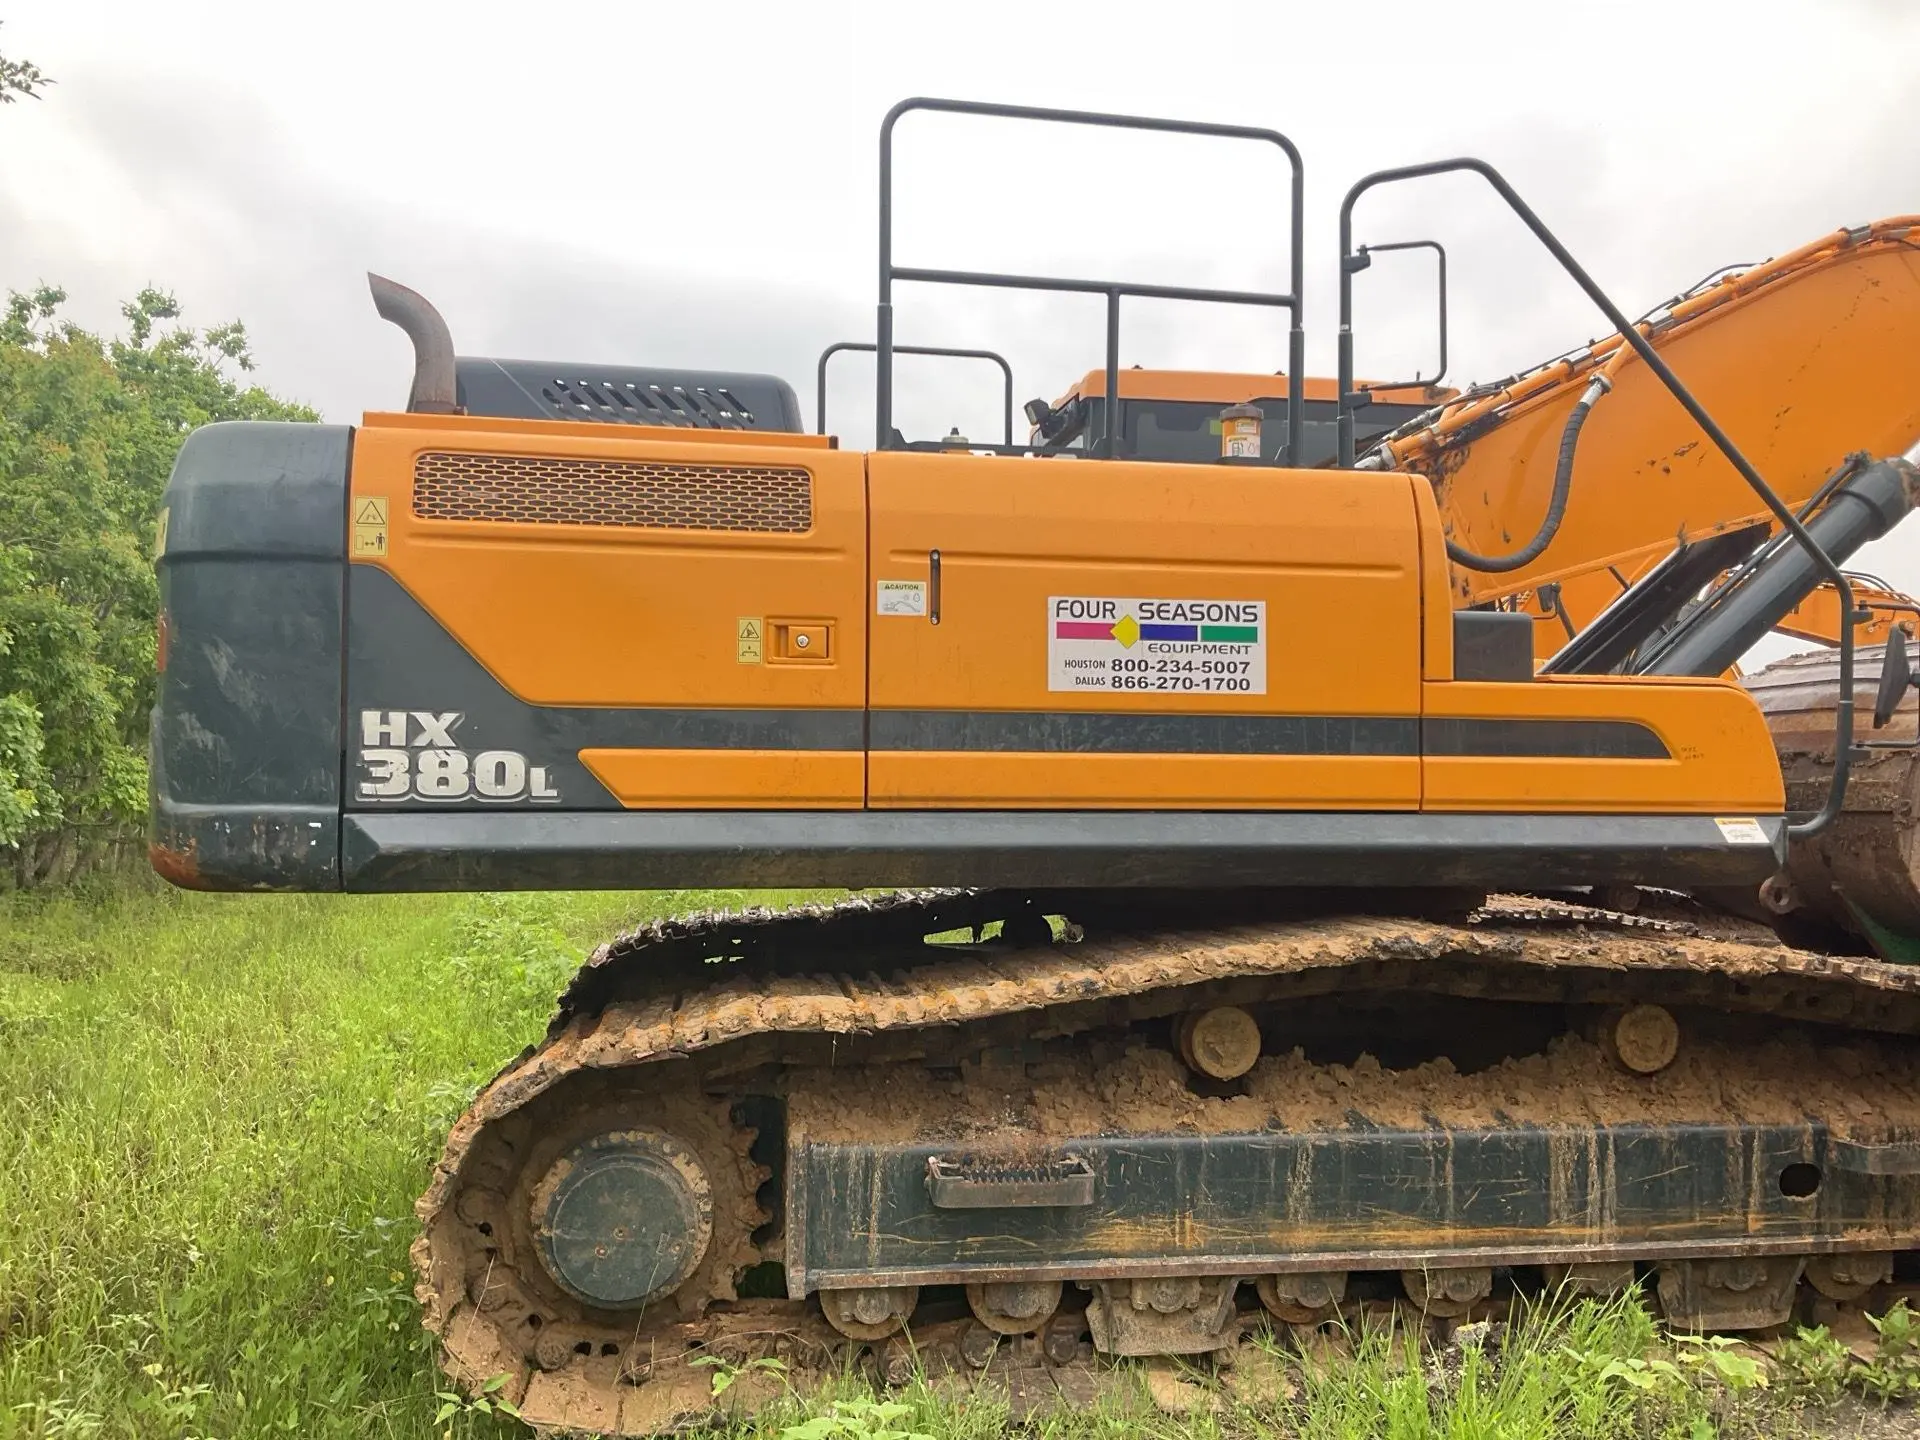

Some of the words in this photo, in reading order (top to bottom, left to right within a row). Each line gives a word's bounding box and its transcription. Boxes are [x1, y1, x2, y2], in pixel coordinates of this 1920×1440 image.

[1056, 600, 1116, 619] FOUR
[1138, 602, 1258, 623] SEASONS
[1147, 643, 1252, 655] EQUIPMENT
[1064, 659, 1106, 669] HOUSTON
[1111, 658, 1251, 674] 800-234-5007
[1075, 676, 1106, 686] DALLAS
[1111, 675, 1251, 691] 866-270-1700
[361, 710, 463, 747] HX
[356, 749, 561, 803] 380L
